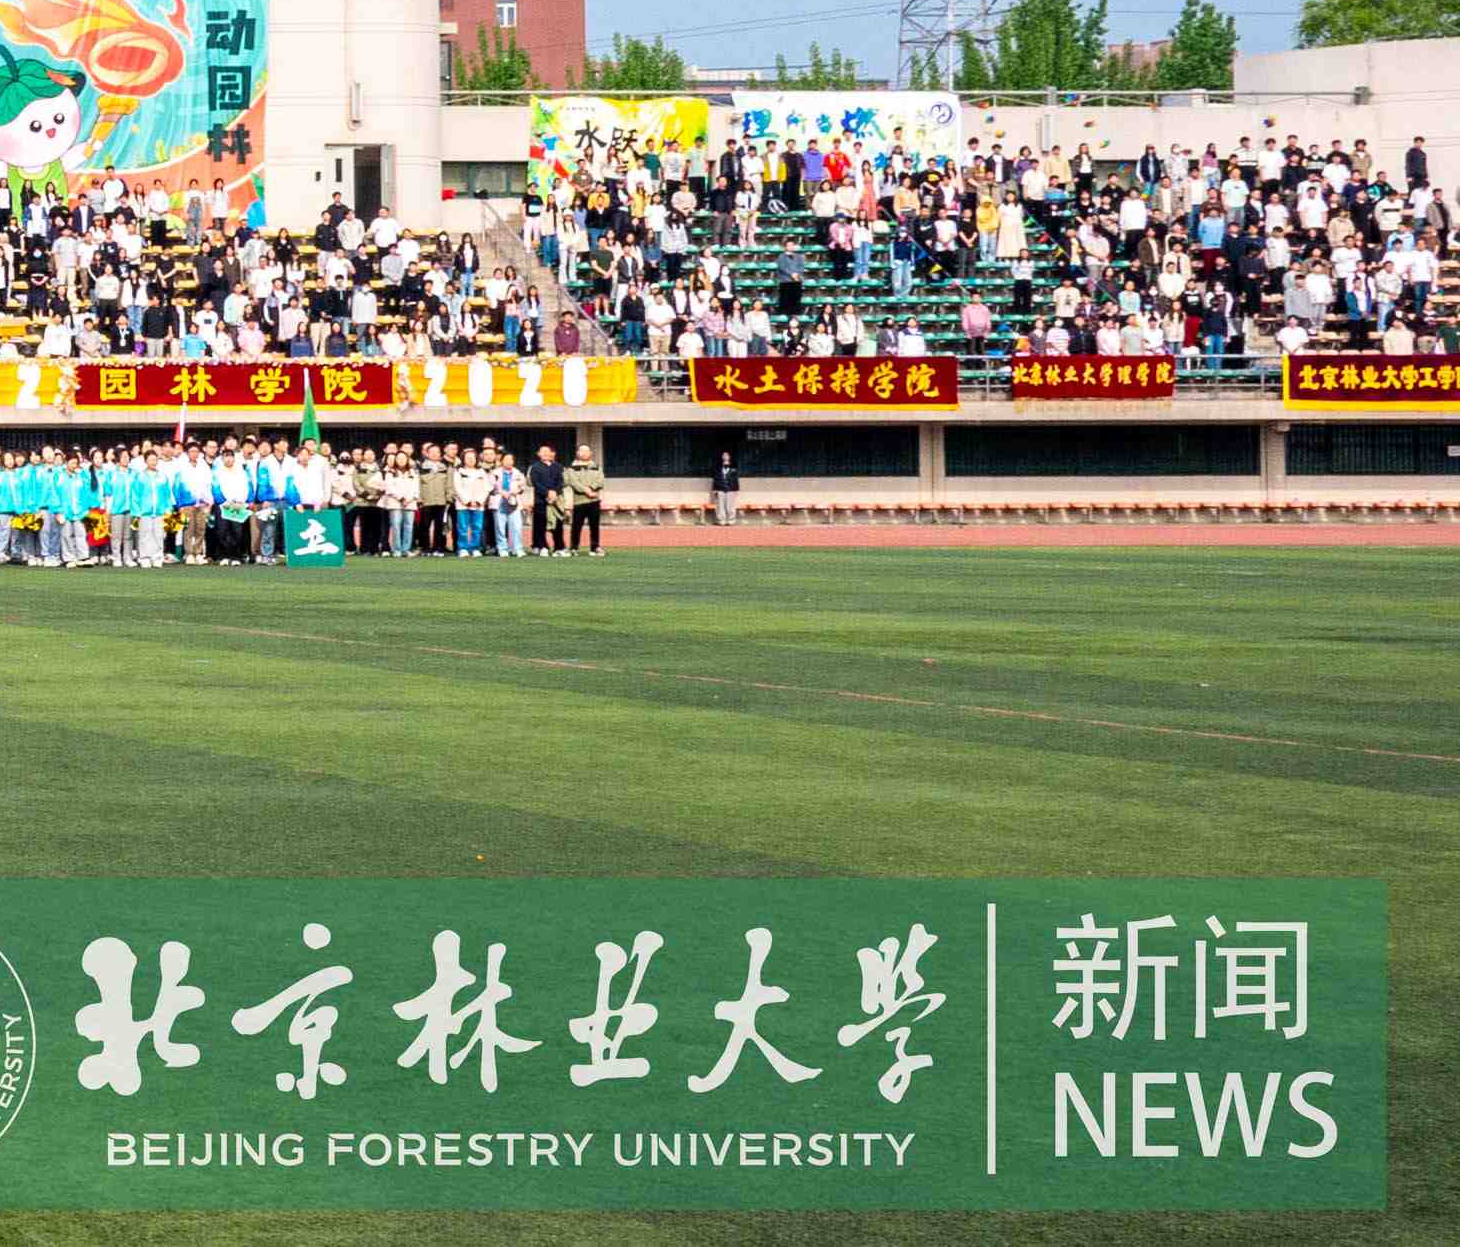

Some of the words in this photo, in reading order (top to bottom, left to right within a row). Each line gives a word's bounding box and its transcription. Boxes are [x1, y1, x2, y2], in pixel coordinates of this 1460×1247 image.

[99, 366, 368, 402] 园林学院
[713, 361, 940, 399] 水土保持学院
[1012, 361, 1174, 387] 北京林业大学理学院
